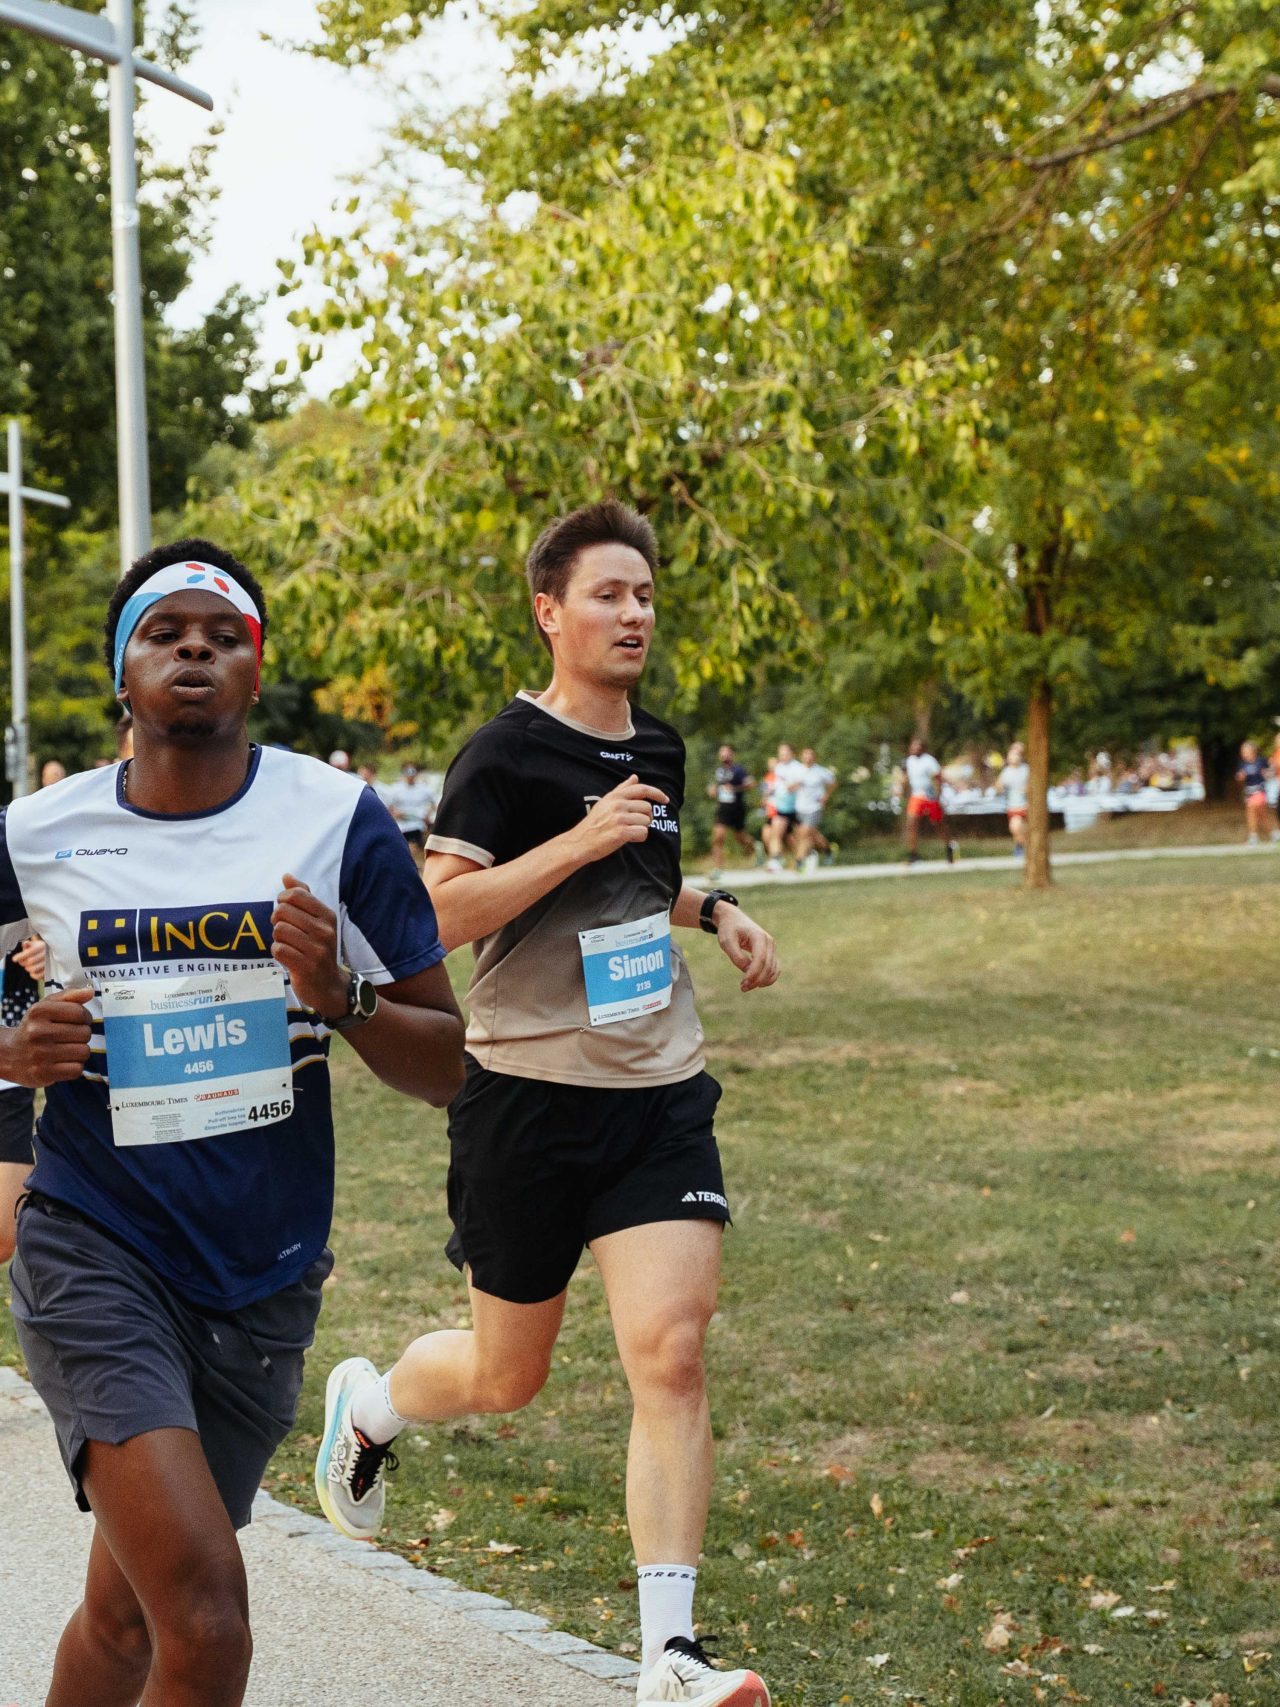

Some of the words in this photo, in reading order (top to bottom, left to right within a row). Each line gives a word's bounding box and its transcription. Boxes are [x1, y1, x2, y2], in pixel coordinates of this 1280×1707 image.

[600, 751, 625, 760] CRAFT
[653, 804, 667, 817] DE
[84, 964, 170, 979] INNOVATIVE
[608, 949, 664, 982] Simon
[143, 1014, 247, 1057] Lewis
[184, 1060, 214, 1075] 4456
[121, 1100, 166, 1109] LUXEMBOURG
[166, 1097, 188, 1105] TIMES
[248, 1100, 292, 1122] 4456
